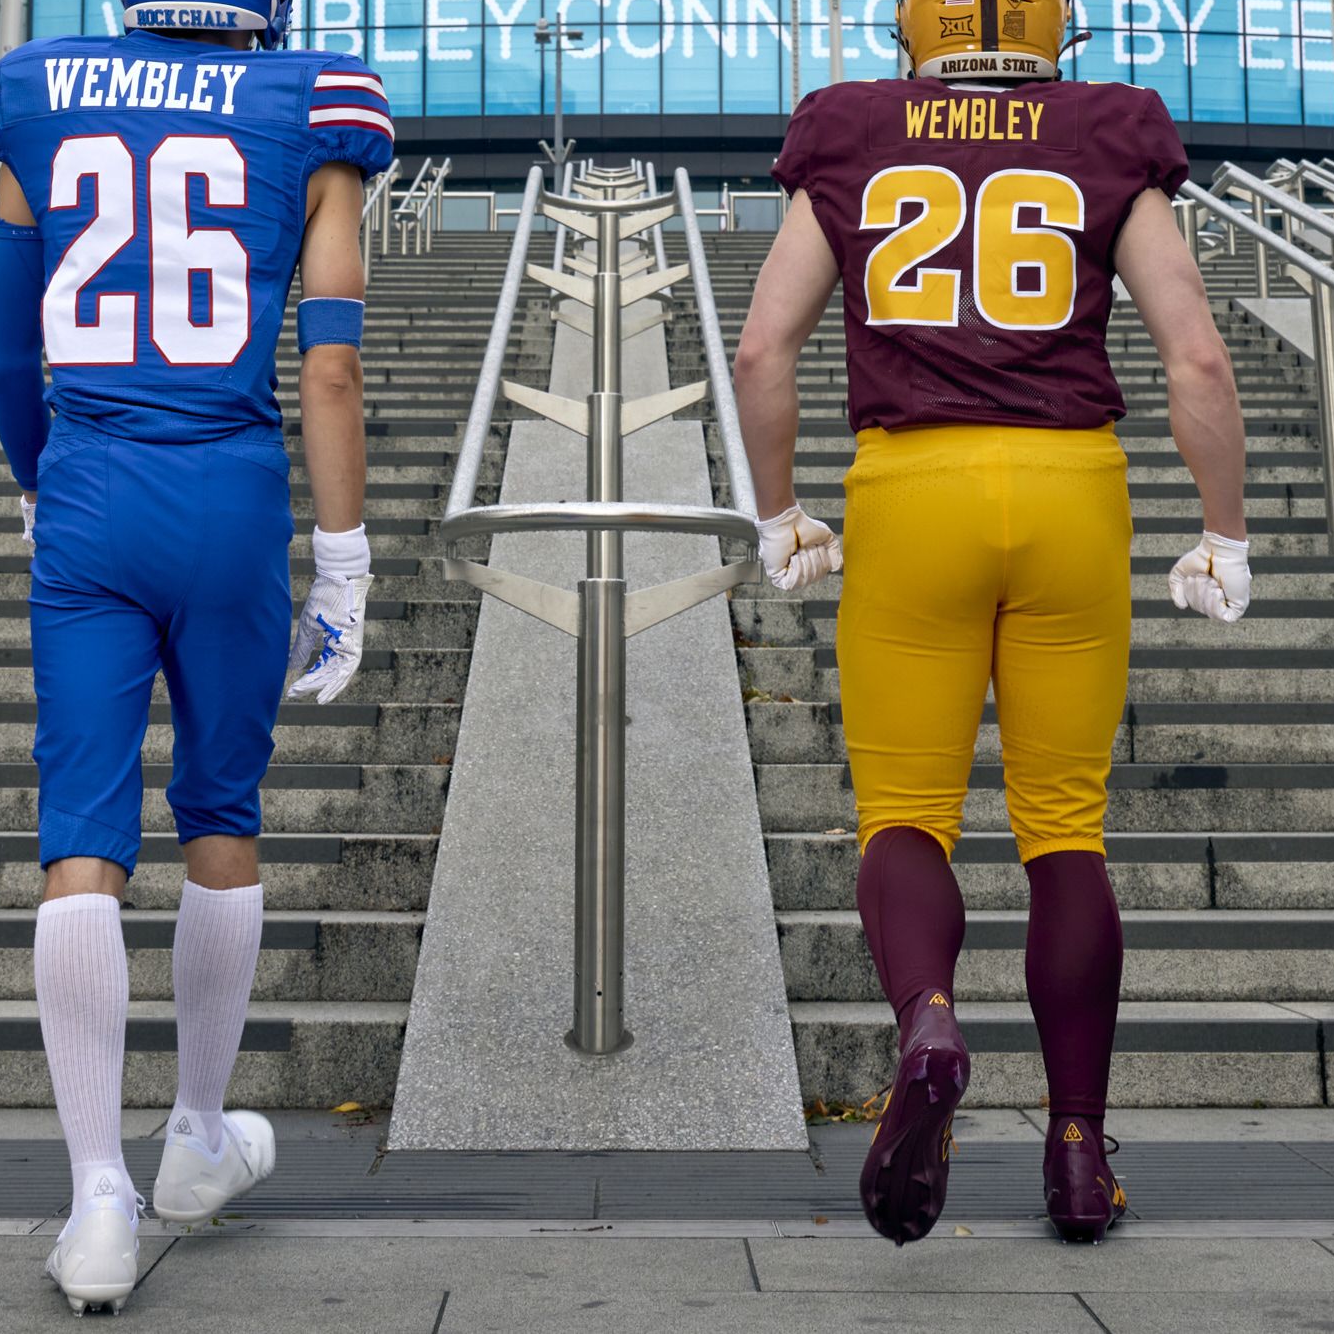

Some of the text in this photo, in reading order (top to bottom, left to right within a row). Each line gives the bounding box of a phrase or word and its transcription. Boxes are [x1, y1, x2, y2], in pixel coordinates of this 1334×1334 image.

[136, 9, 238, 28] ROCK CHALK
[45, 58, 247, 114] WEMBLEY
[940, 57, 1039, 74] ARIZONA STATE
[905, 97, 1044, 141] WEMBLEY
[40, 132, 252, 367] 26
[859, 164, 1085, 331] 26
